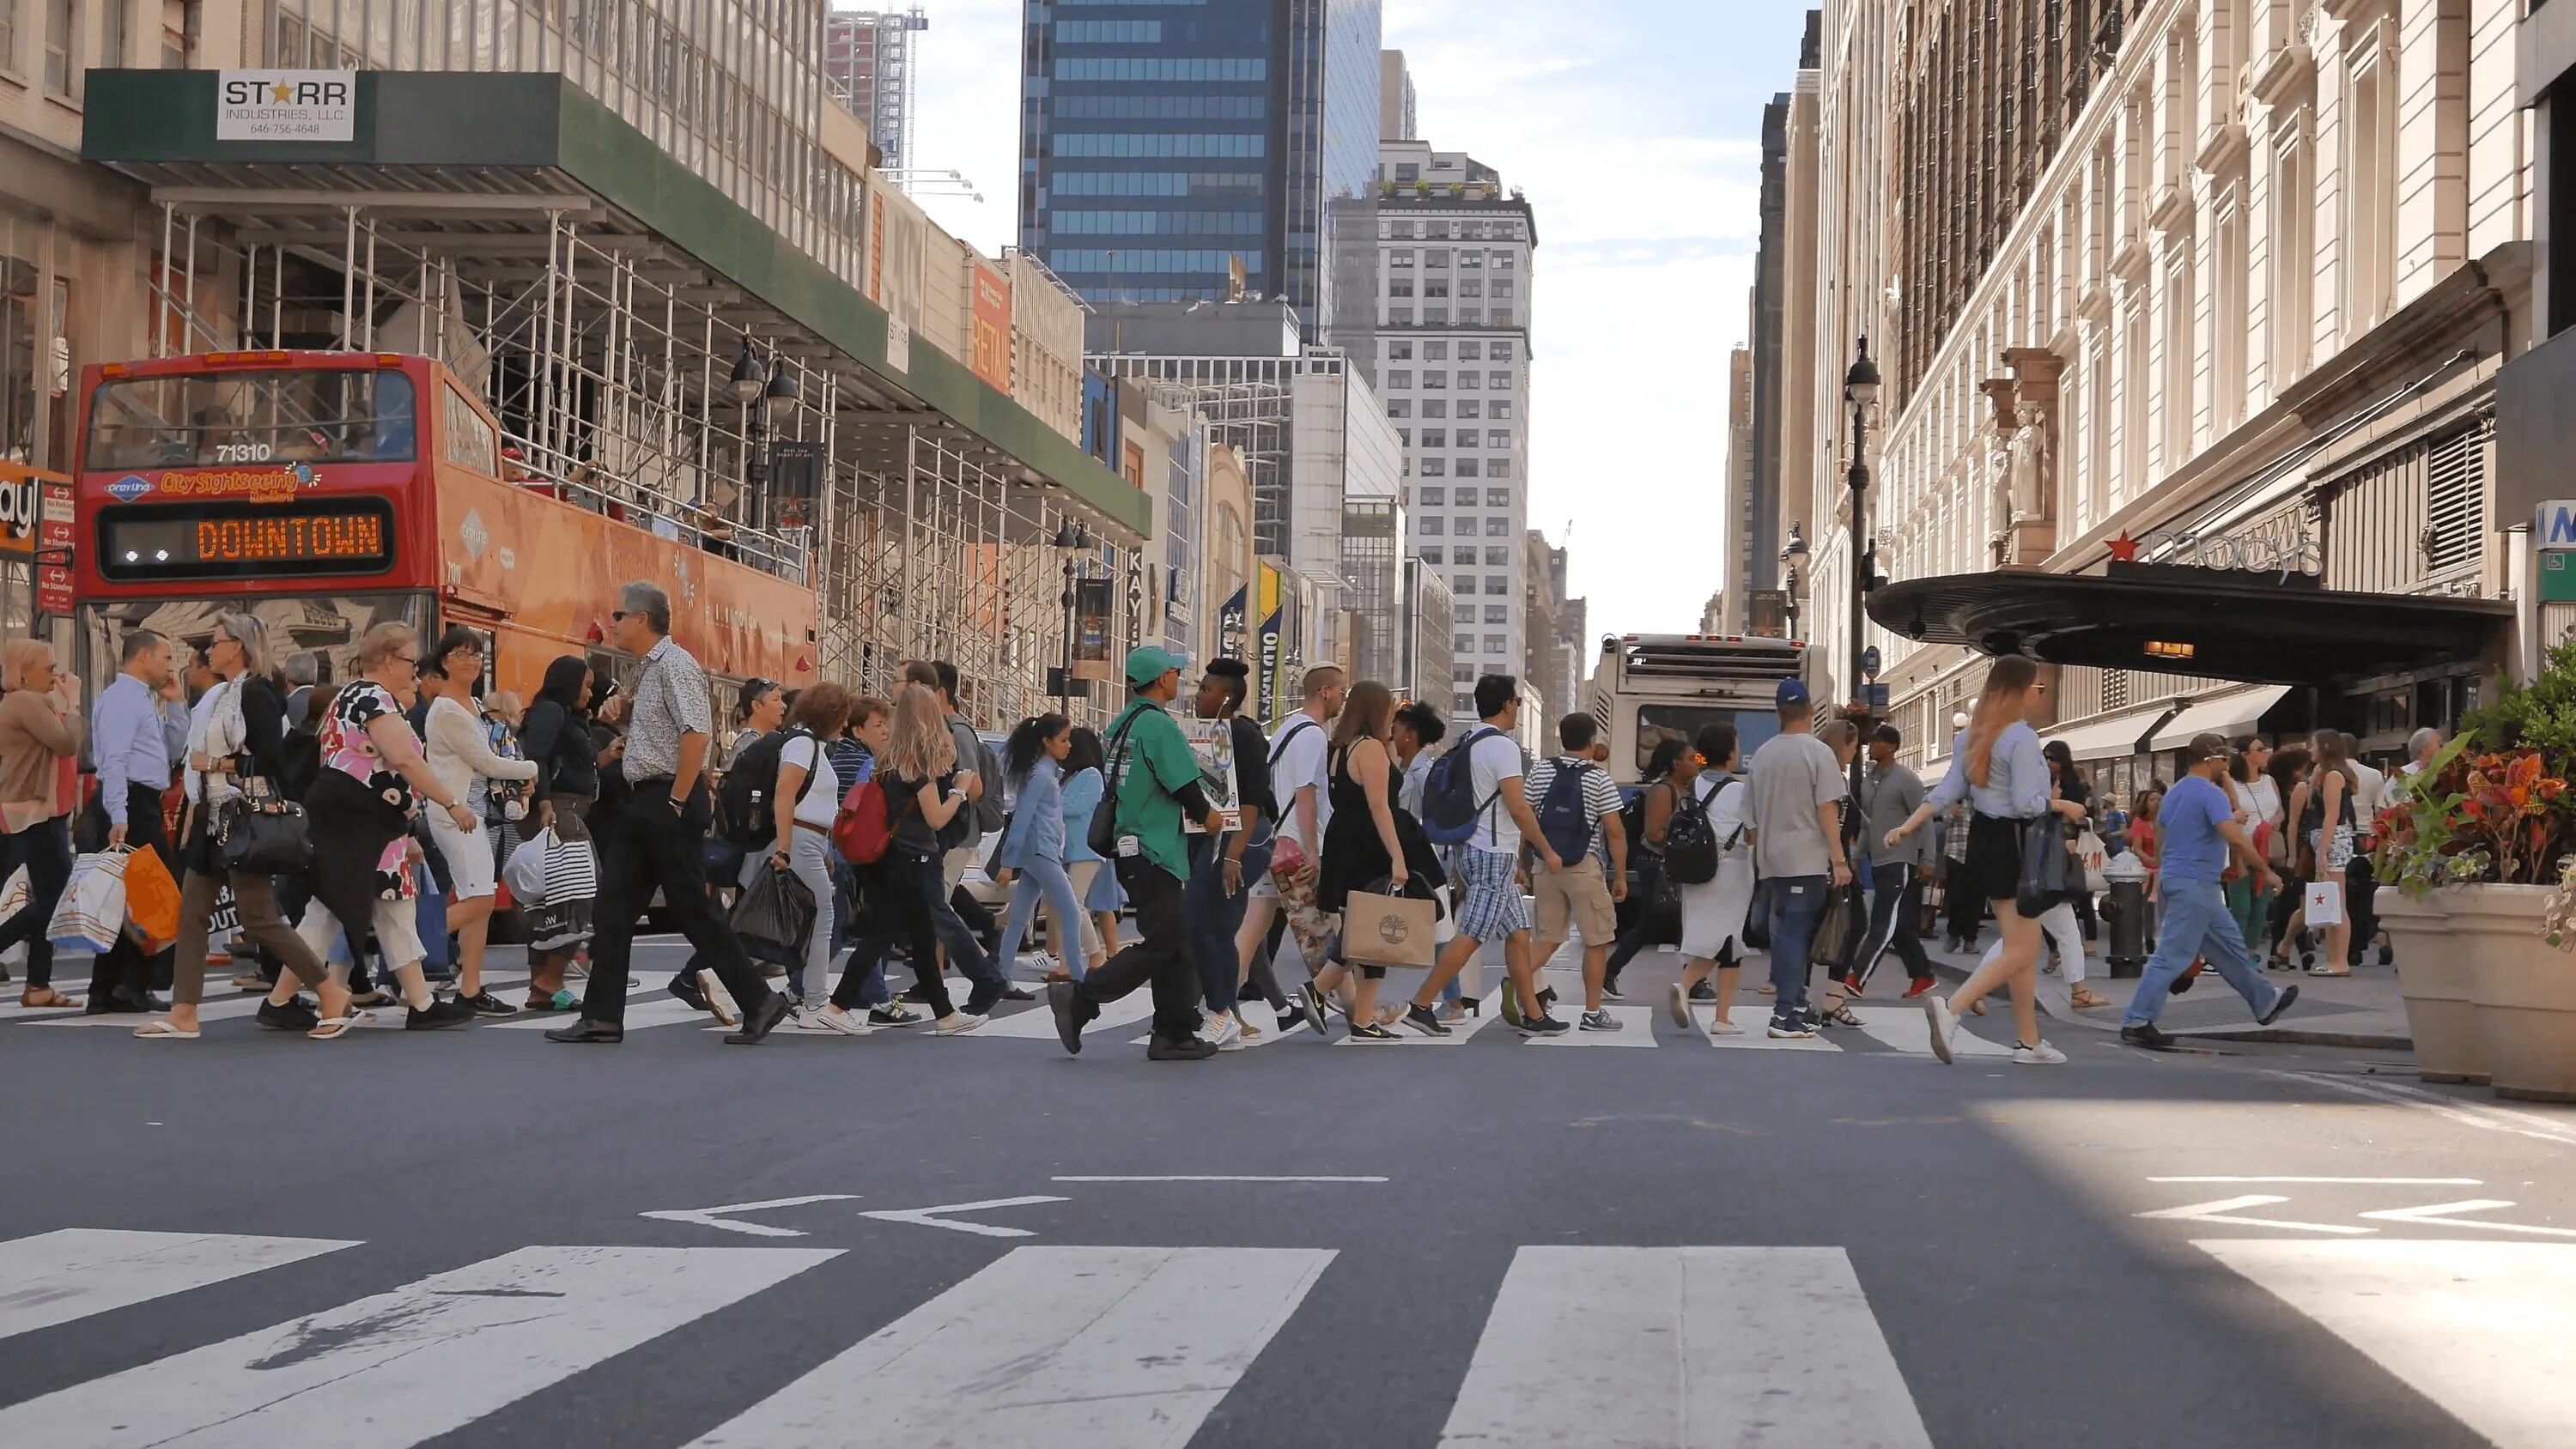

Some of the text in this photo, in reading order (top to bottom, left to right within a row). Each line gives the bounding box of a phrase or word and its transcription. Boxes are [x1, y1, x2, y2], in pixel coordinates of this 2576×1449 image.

[251, 124, 319, 134] 646-756-4648
[216, 444, 270, 462] 71310
[198, 516, 378, 558] DOWNTOWN
[1128, 552, 1142, 617] KAY
[1262, 632, 1279, 667] OLD
